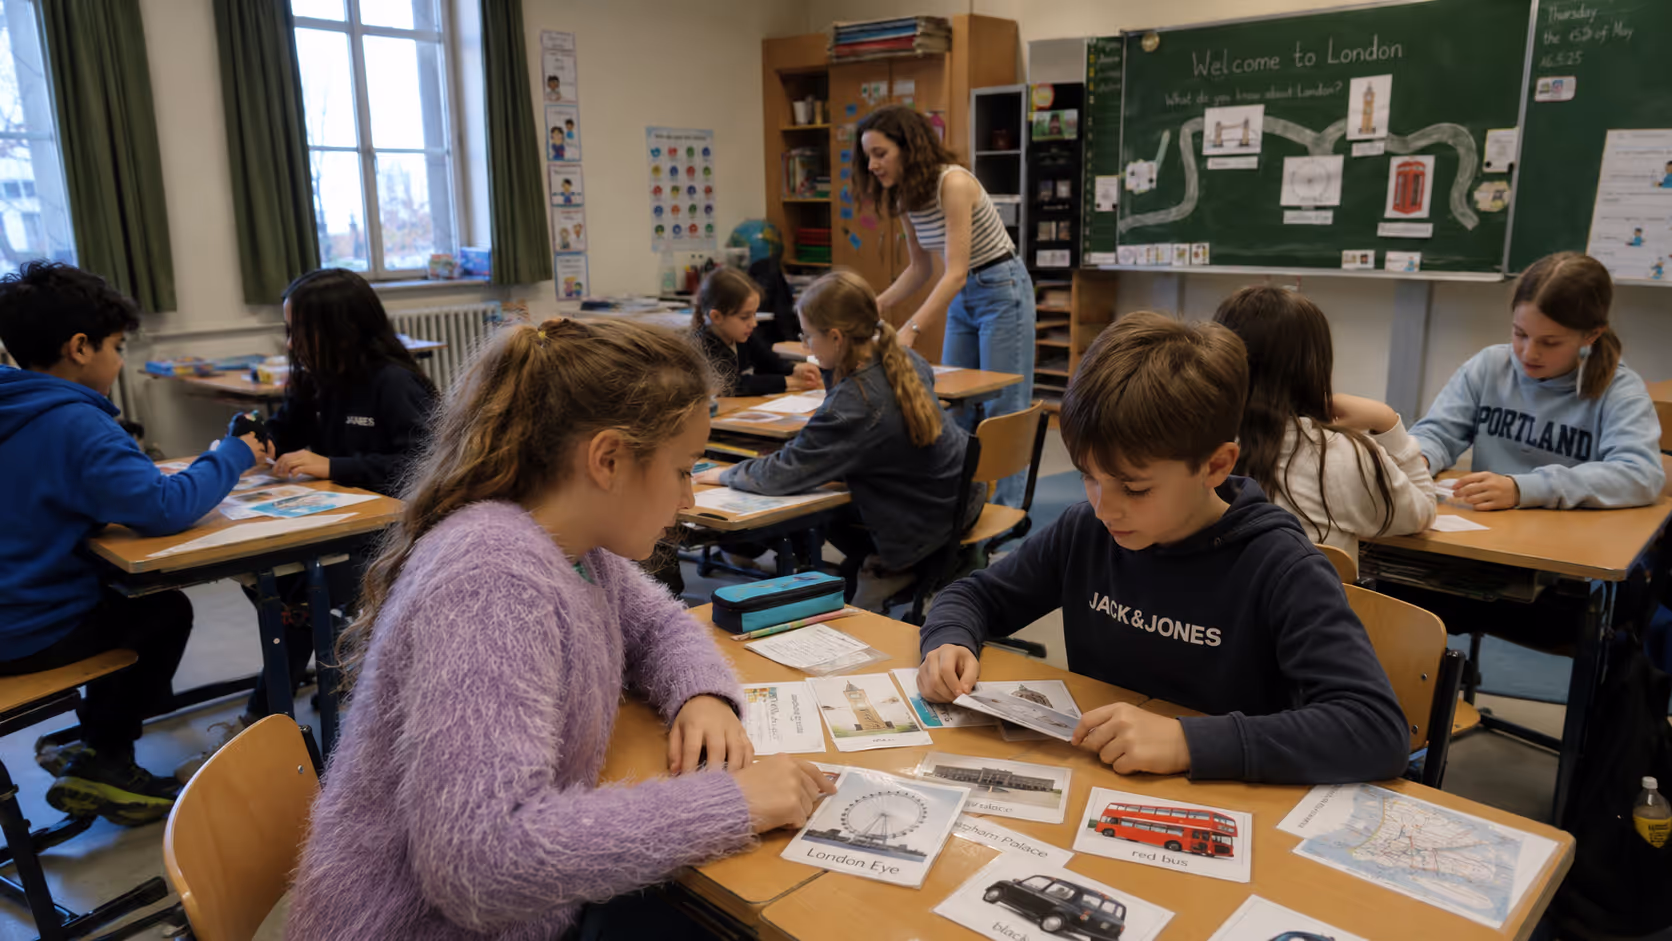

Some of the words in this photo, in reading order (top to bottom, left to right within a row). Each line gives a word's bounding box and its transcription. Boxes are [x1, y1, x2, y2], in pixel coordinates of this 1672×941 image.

[1549, 3, 1598, 23] Thursday
[1543, 31, 1560, 45] the
[1595, 25, 1609, 45] of
[1612, 20, 1634, 40] May
[1192, 50, 1280, 78] Welcome
[1294, 41, 1316, 68] to
[1327, 34, 1403, 64] London
[1165, 93, 1192, 106] What
[1196, 90, 1209, 104] do
[1213, 93, 1231, 106] you
[1235, 87, 1260, 100] know
[1264, 84, 1292, 99] about
[1297, 80, 1343, 98] London?
[1479, 406, 1593, 461] PORTLAND
[1089, 592, 1222, 647] JACK&JONES
[1001, 836, 1048, 859] Palace
[1131, 851, 1156, 861] red
[1161, 854, 1189, 867] bus
[806, 847, 865, 868] London
[870, 860, 900, 875] Eye
